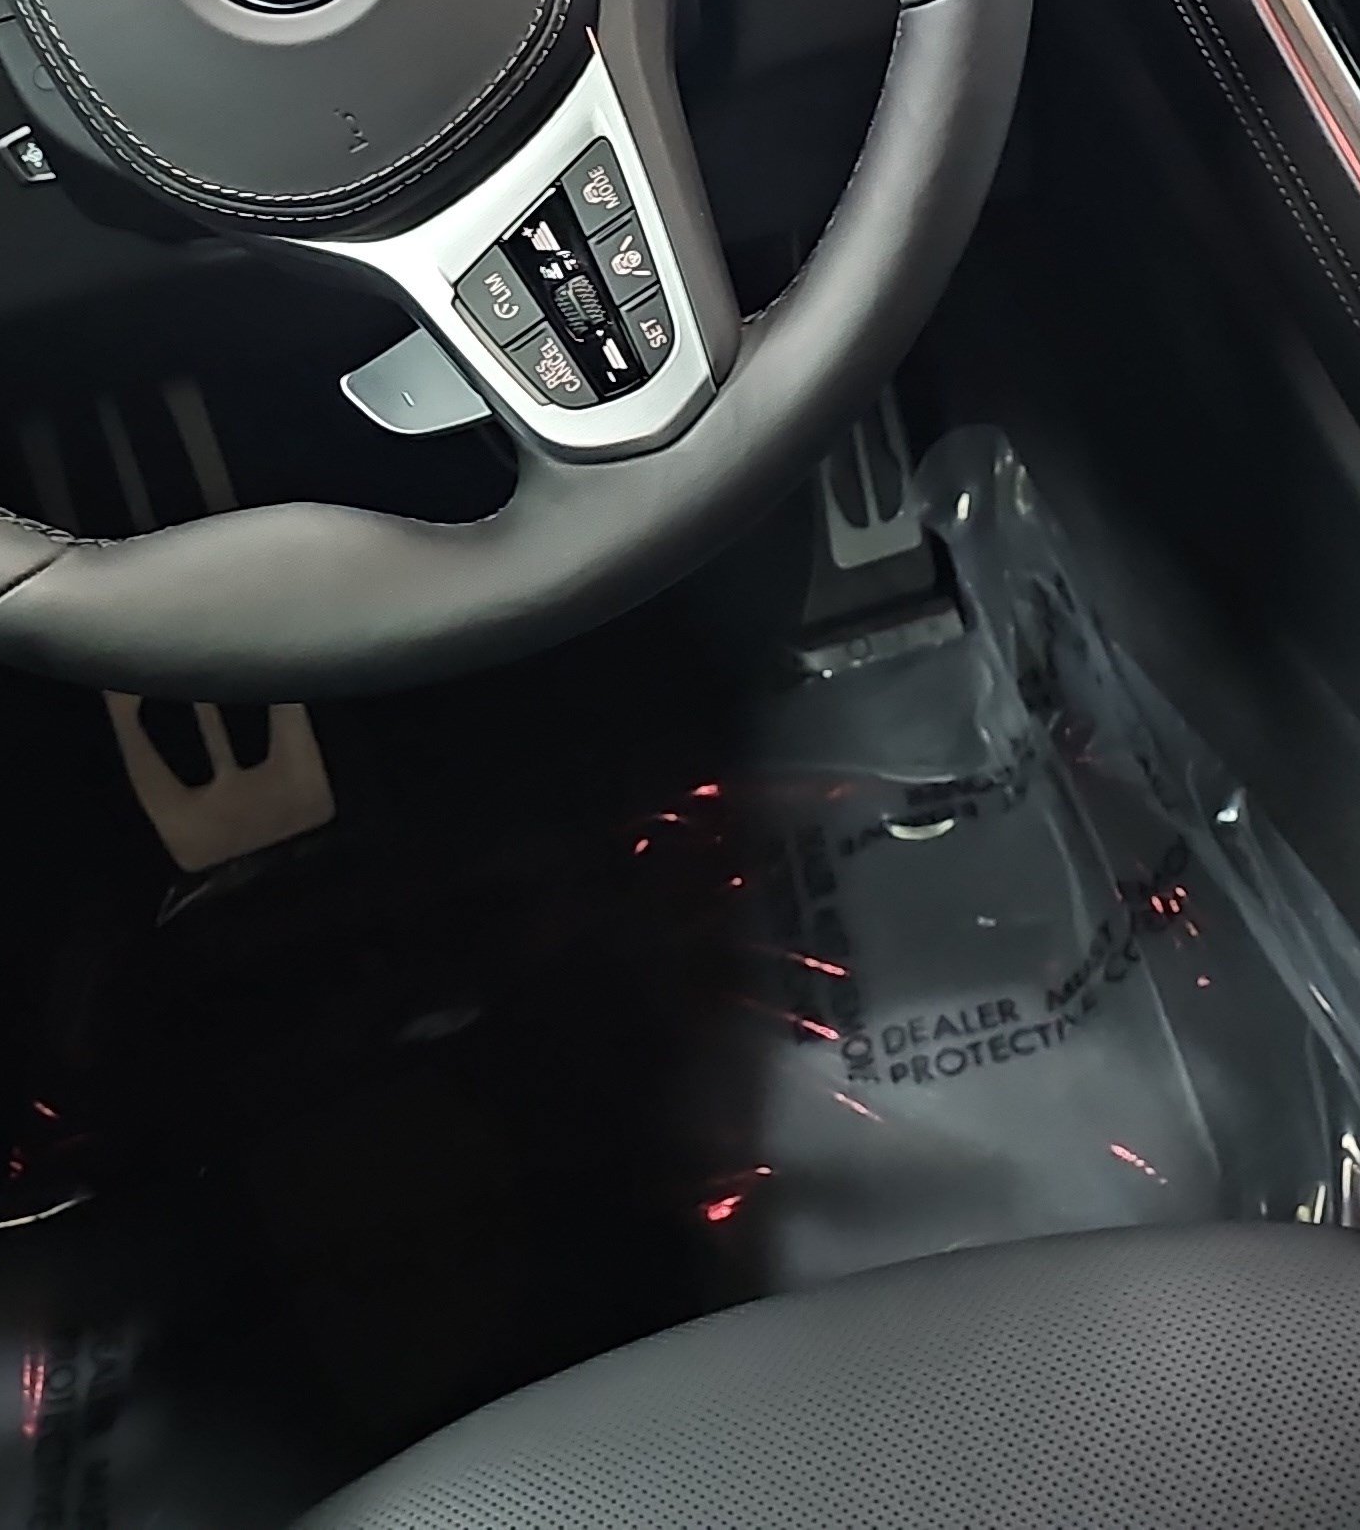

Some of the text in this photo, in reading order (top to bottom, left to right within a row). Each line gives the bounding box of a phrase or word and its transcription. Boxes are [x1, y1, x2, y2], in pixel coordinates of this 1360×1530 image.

[589, 166, 621, 210] MODE
[484, 272, 515, 303] LIM
[640, 318, 668, 349] SET
[535, 358, 562, 389] RES
[540, 337, 581, 392] CANCEL
[881, 998, 1021, 1056] DEALER
